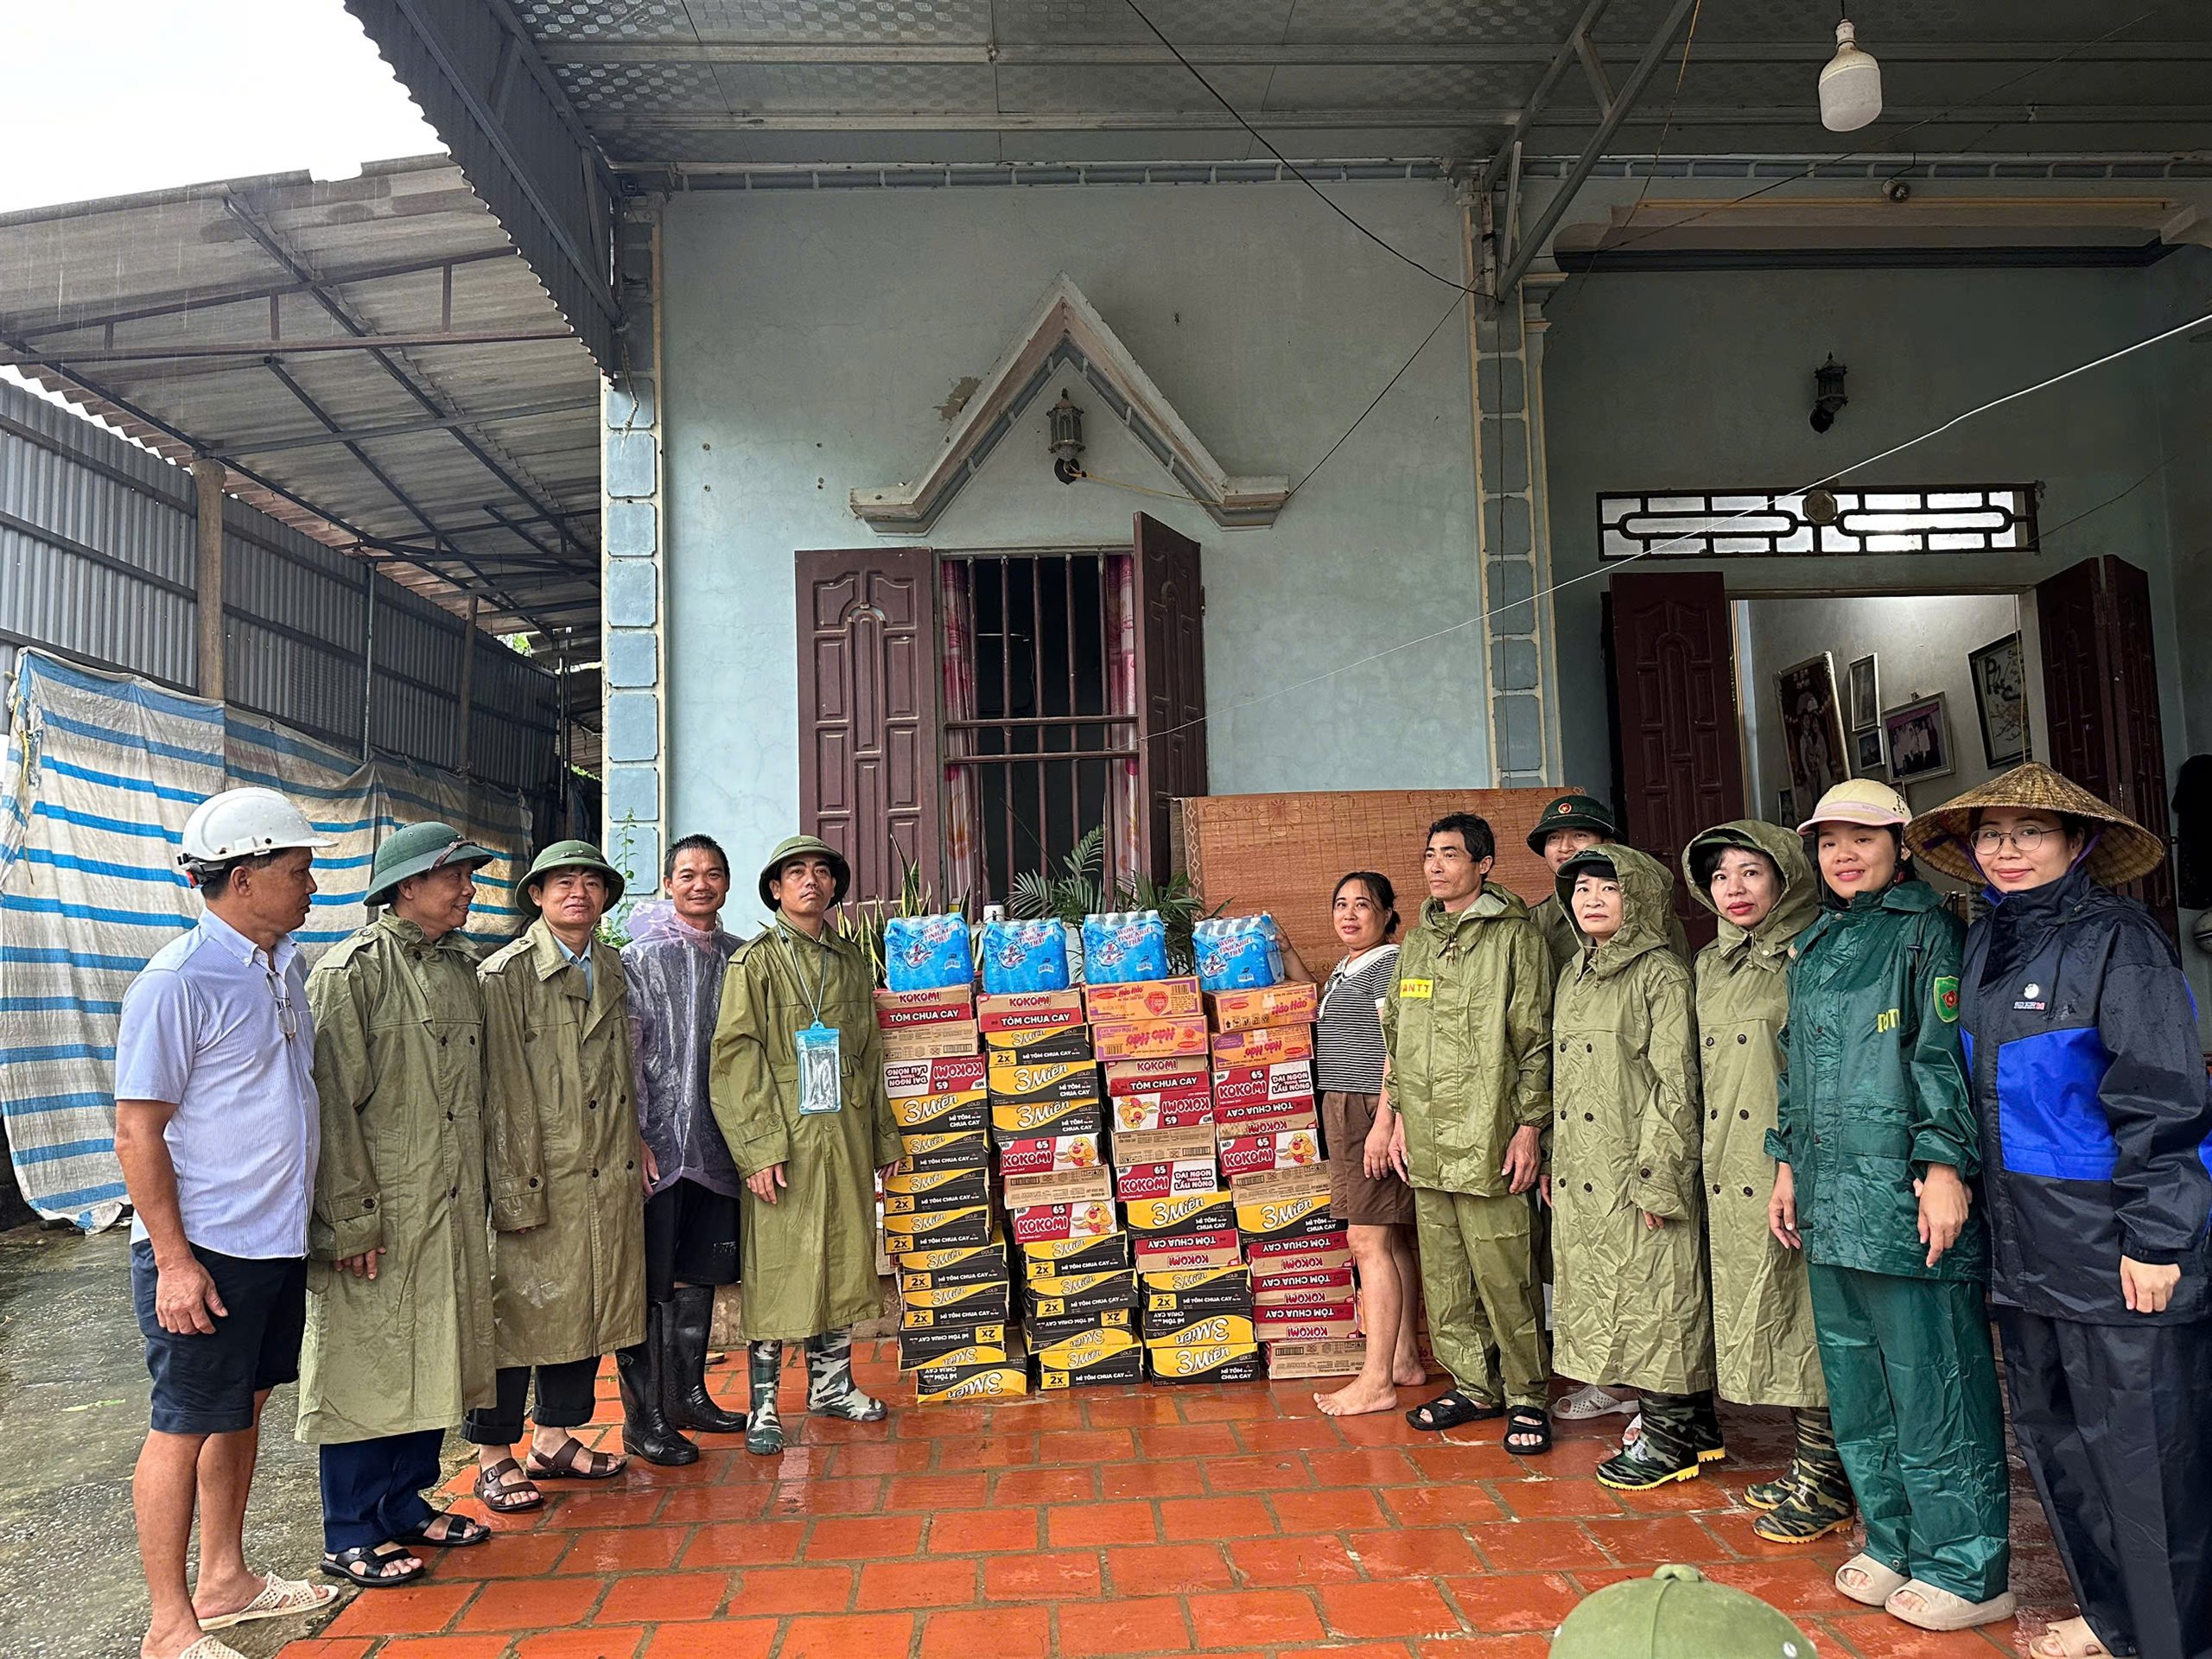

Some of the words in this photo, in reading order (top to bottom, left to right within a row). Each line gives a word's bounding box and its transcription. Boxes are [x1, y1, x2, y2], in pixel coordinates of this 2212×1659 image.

[899, 992, 940, 1002] KOKOMI
[1009, 995, 1050, 1007] KOKOMI
[890, 1012, 910, 1022] TÔM
[941, 1009, 958, 1018] CAY
[1001, 1016, 1022, 1026] TÔM
[1024, 1015, 1050, 1024] CHUA
[933, 1063, 983, 1079] KOKOMI
[1137, 1059, 1177, 1071] KOKOMI
[1251, 1071, 1263, 1079] 65
[1130, 1081, 1151, 1090] TÔM
[1153, 1079, 1178, 1088] CHUA
[1179, 1077, 1198, 1085] CAY
[1218, 1081, 1267, 1098] KOKOMI
[1162, 1097, 1211, 1115] KOKOMI
[1247, 1104, 1272, 1114] CHUA
[1226, 1108, 1244, 1117] CAY
[1257, 1138, 1268, 1147] 65
[1002, 1151, 1052, 1166] KOKOMI
[1224, 1148, 1274, 1166] KOKOMI
[1119, 1176, 1169, 1193] KOKOMI
[1018, 1216, 1068, 1234] KOKOMI
[1168, 1238, 1194, 1247] CHUA
[1262, 1243, 1281, 1252] CAY
[1283, 1240, 1309, 1249] CHUA
[1168, 1255, 1209, 1267] KOKOMI
[1282, 1257, 1323, 1270] KOKOMI
[1262, 1279, 1281, 1287] CAY
[1282, 1276, 1308, 1285] CHUA
[1285, 1292, 1325, 1304] KOKOMI
[1287, 1326, 1328, 1338] KOKOMI
